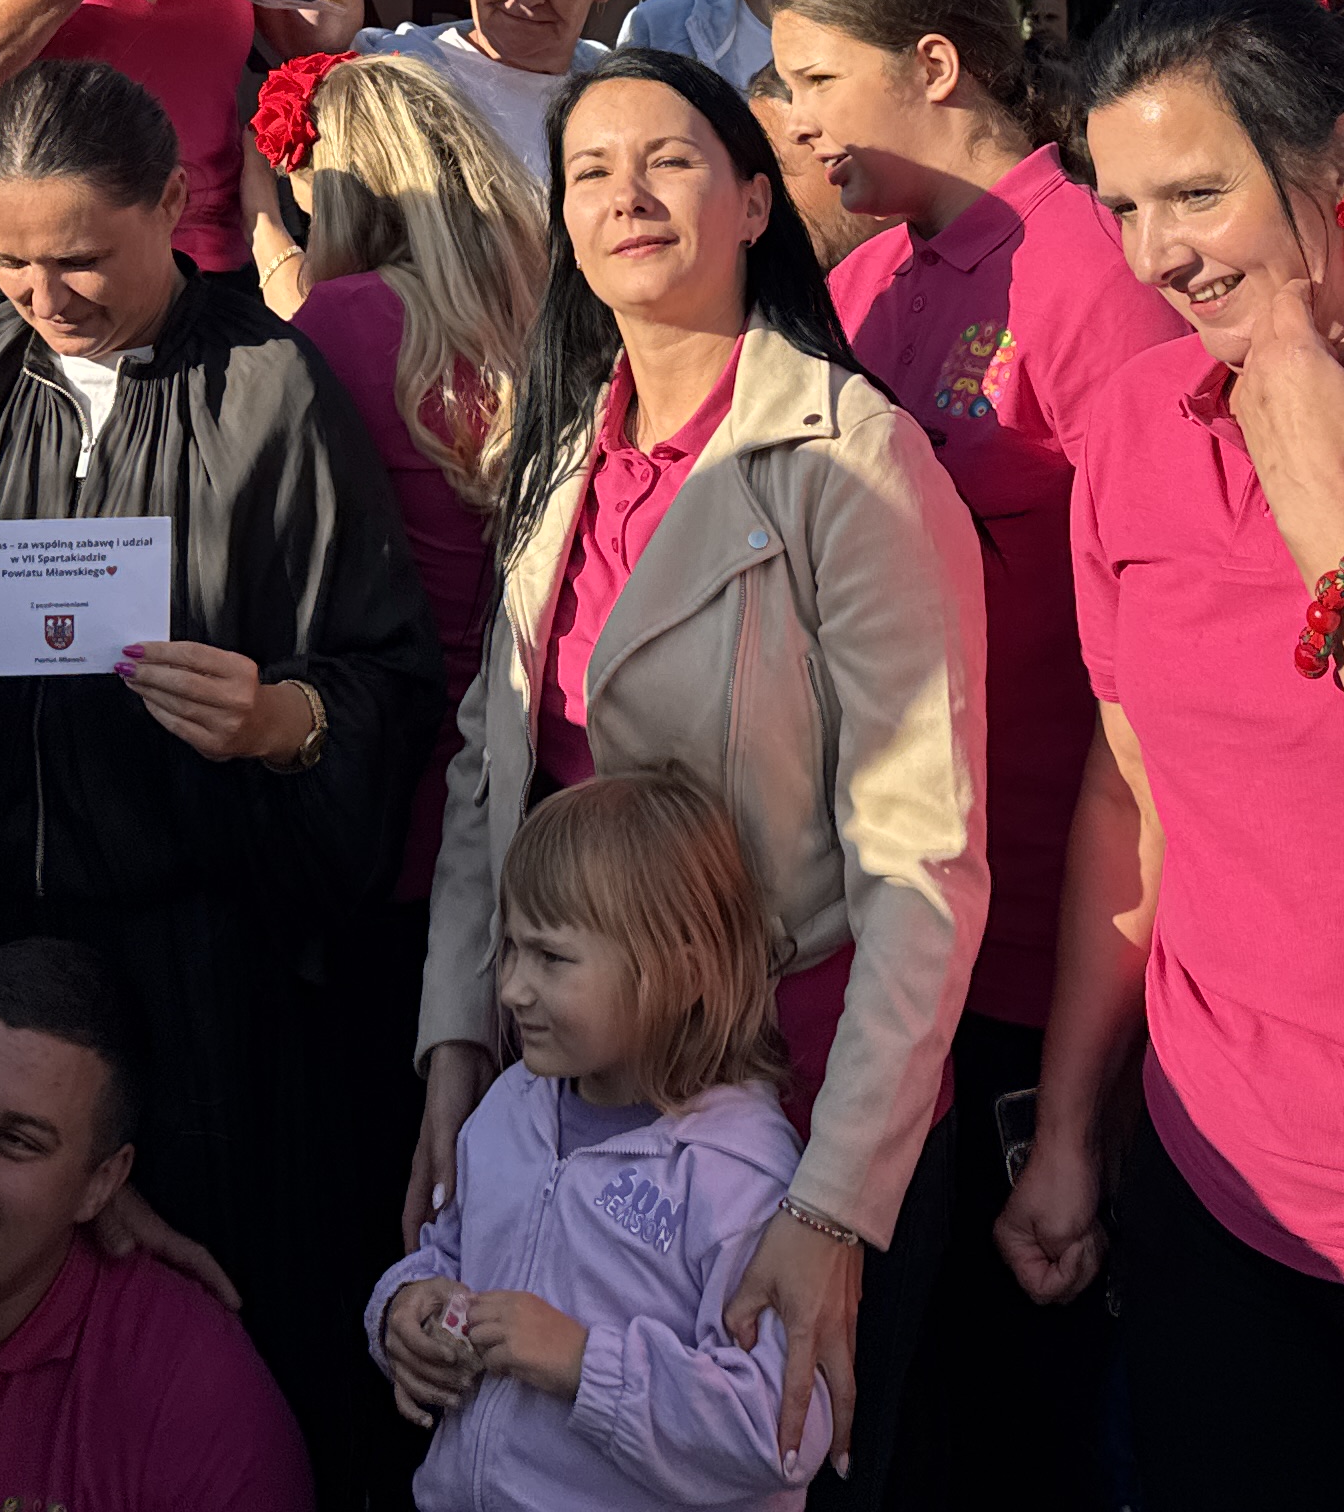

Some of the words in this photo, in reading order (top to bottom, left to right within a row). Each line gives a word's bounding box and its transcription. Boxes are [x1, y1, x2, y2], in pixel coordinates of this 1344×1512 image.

[17, 542, 29, 550] za
[30, 539, 74, 551] wspólną
[75, 538, 114, 550] zabawę
[10, 556, 19, 564] w
[21, 555, 35, 563] VII
[37, 552, 107, 565] Spartakiadzie
[1, 568, 43, 578] Powiatu
[45, 567, 106, 578] Mławskiego
[603, 1167, 685, 1232] SUN
[594, 1191, 675, 1255] SEASON
